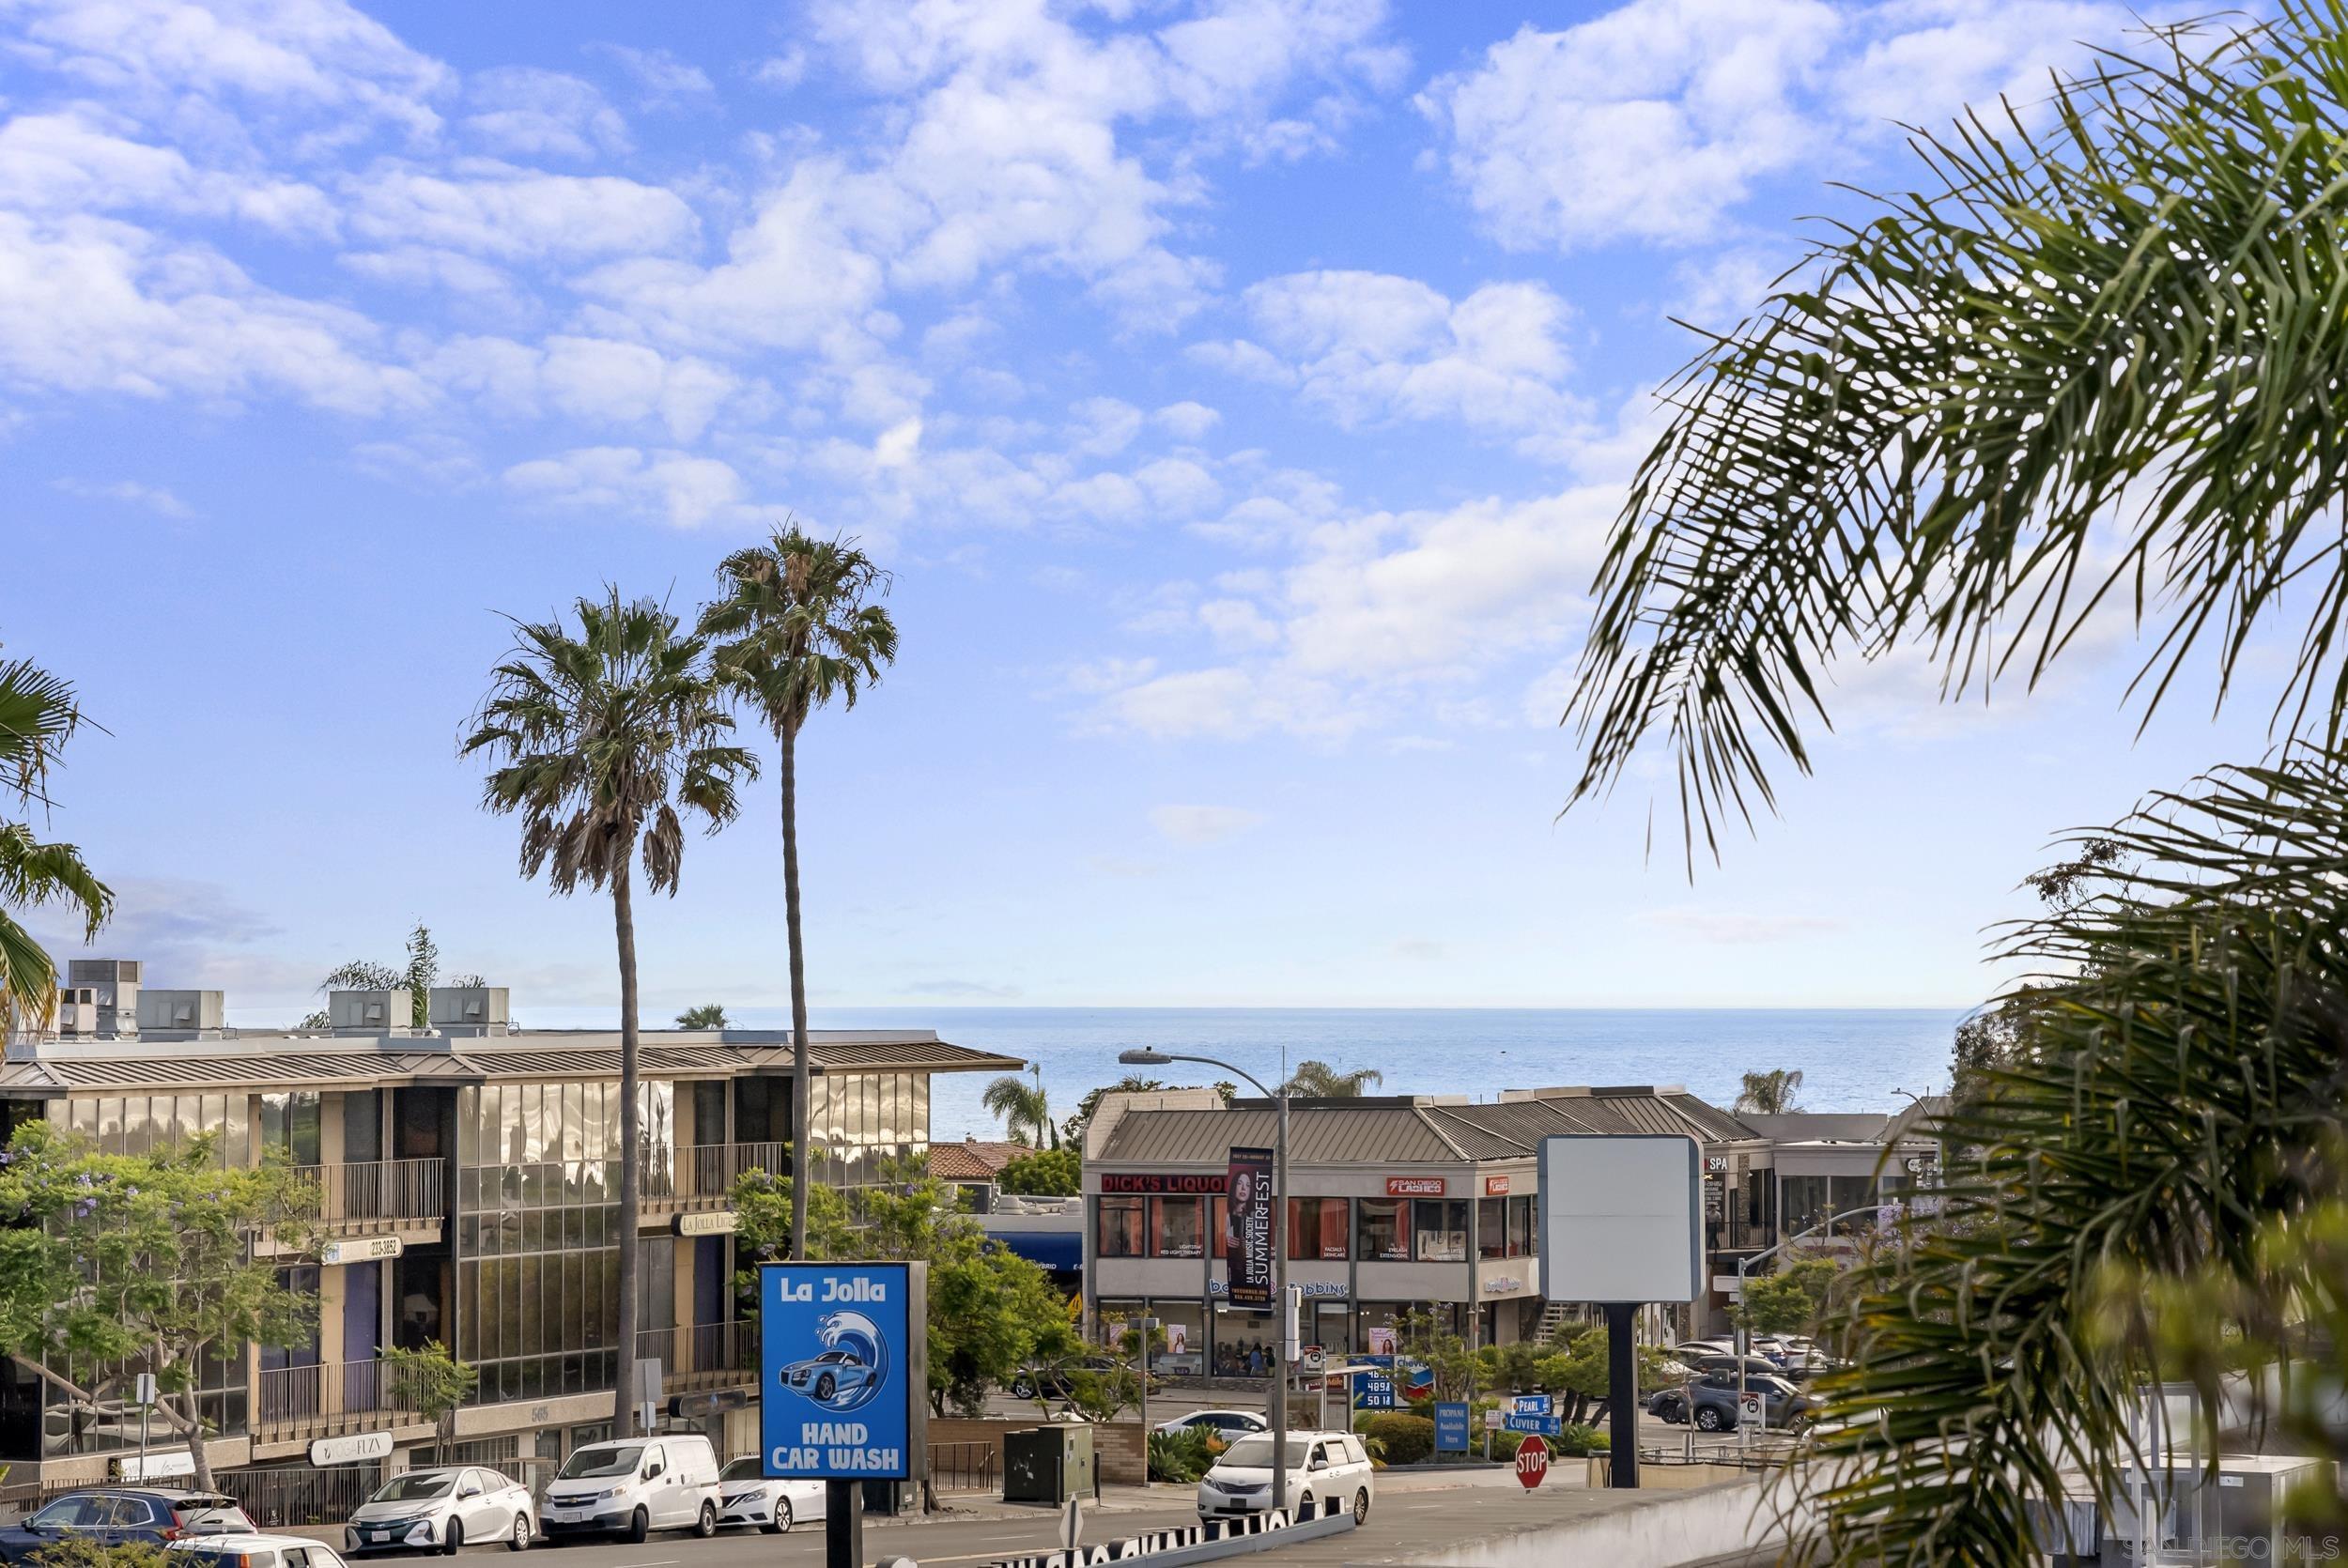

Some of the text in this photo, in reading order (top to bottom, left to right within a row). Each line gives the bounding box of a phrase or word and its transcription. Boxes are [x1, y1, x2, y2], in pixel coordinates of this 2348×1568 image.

[1710, 1158, 1727, 1170] SPA
[1103, 1176, 1227, 1191] DICK'S LIQUO
[683, 1217, 693, 1231] LA
[694, 1216, 714, 1232] JOLLA
[1245, 1216, 1254, 1238] SOCIETY
[1255, 1171, 1270, 1285] SUMMERFEST
[1245, 1239, 1254, 1257] MUSIC
[1245, 1259, 1254, 1275] JOLLA
[780, 1277, 886, 1302] La Jolla
[1519, 1400, 1539, 1412] PEARL
[1509, 1416, 1540, 1431] CUVIER
[802, 1422, 868, 1445] HAND
[1445, 1435, 1458, 1443] Here
[772, 1447, 899, 1470] CAR WASH
[1518, 1452, 1547, 1473] STOP
